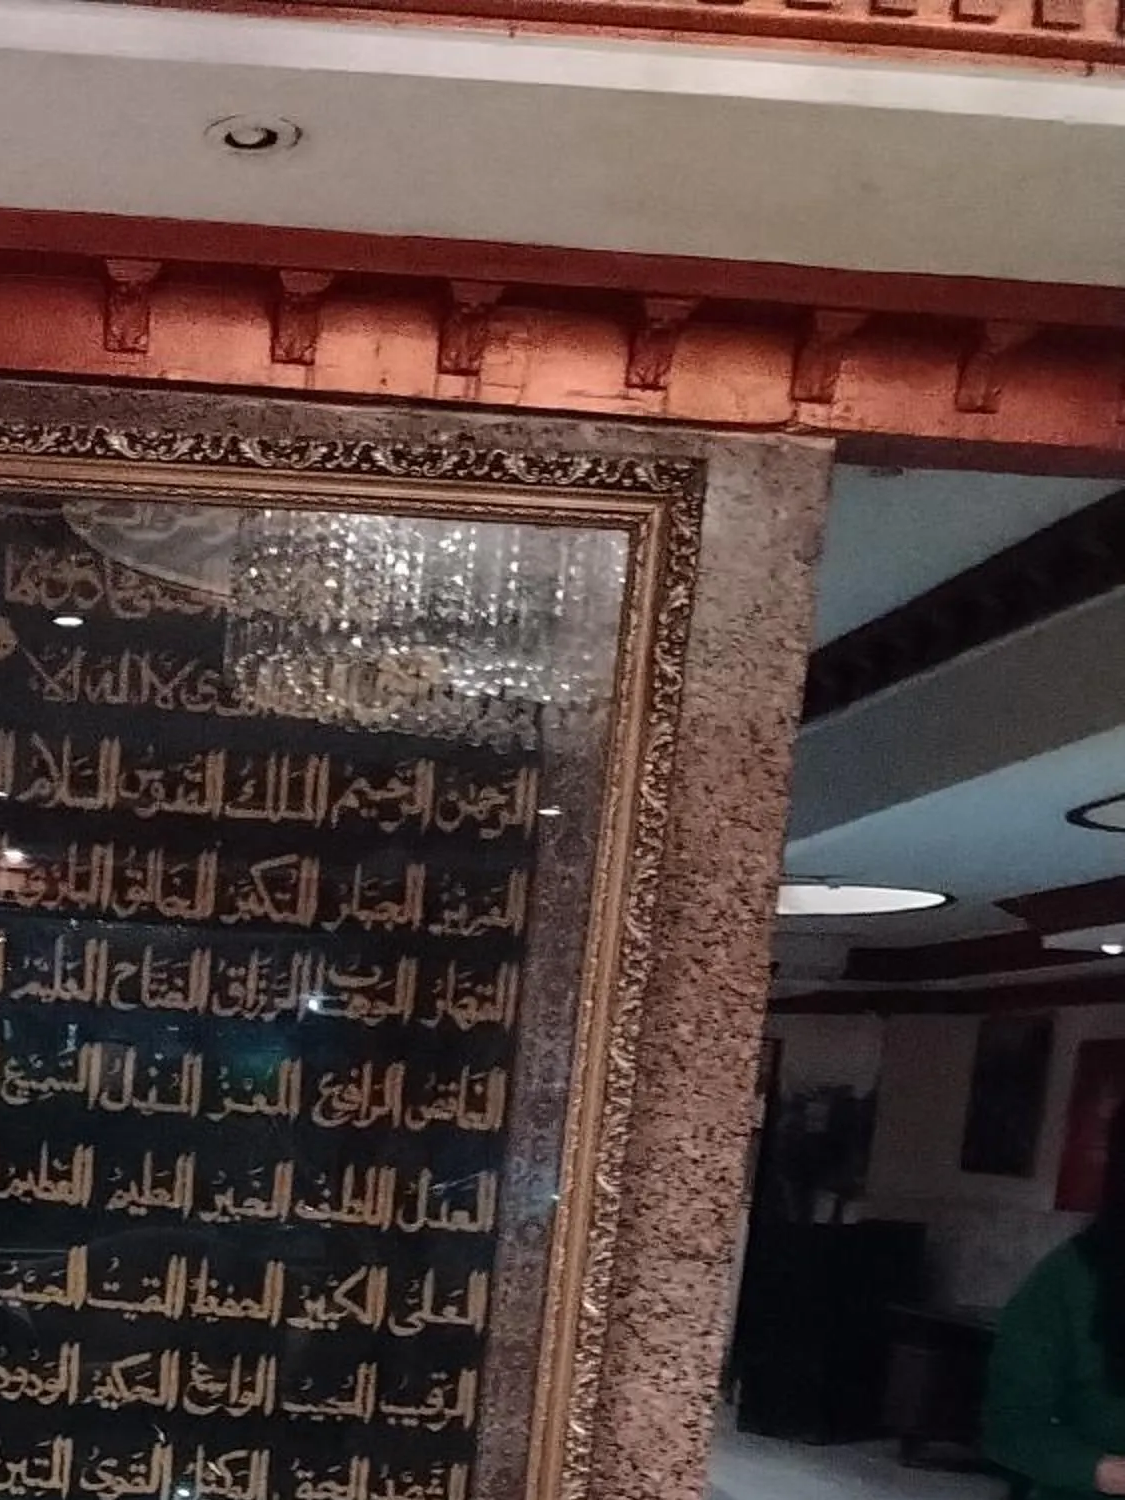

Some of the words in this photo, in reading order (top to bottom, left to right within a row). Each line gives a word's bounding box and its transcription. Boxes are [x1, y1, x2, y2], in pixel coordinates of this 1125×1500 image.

[16, 733, 120, 810] السلام
[120, 742, 225, 820] القدوس
[225, 750, 330, 826] الملك
[332, 754, 434, 831] الرحيم
[436, 764, 536, 838] الرحمن
[8, 934, 108, 1005] العليم
[1, 1038, 100, 1108] السميع
[311, 1058, 405, 1131] الرافع
[199, 1154, 295, 1224] الخبير
[396, 1169, 497, 1236] العدل
[285, 1261, 388, 1332] الكبير
[79, 1344, 180, 1412] الحكيم
[379, 1365, 476, 1431] الرقيب
